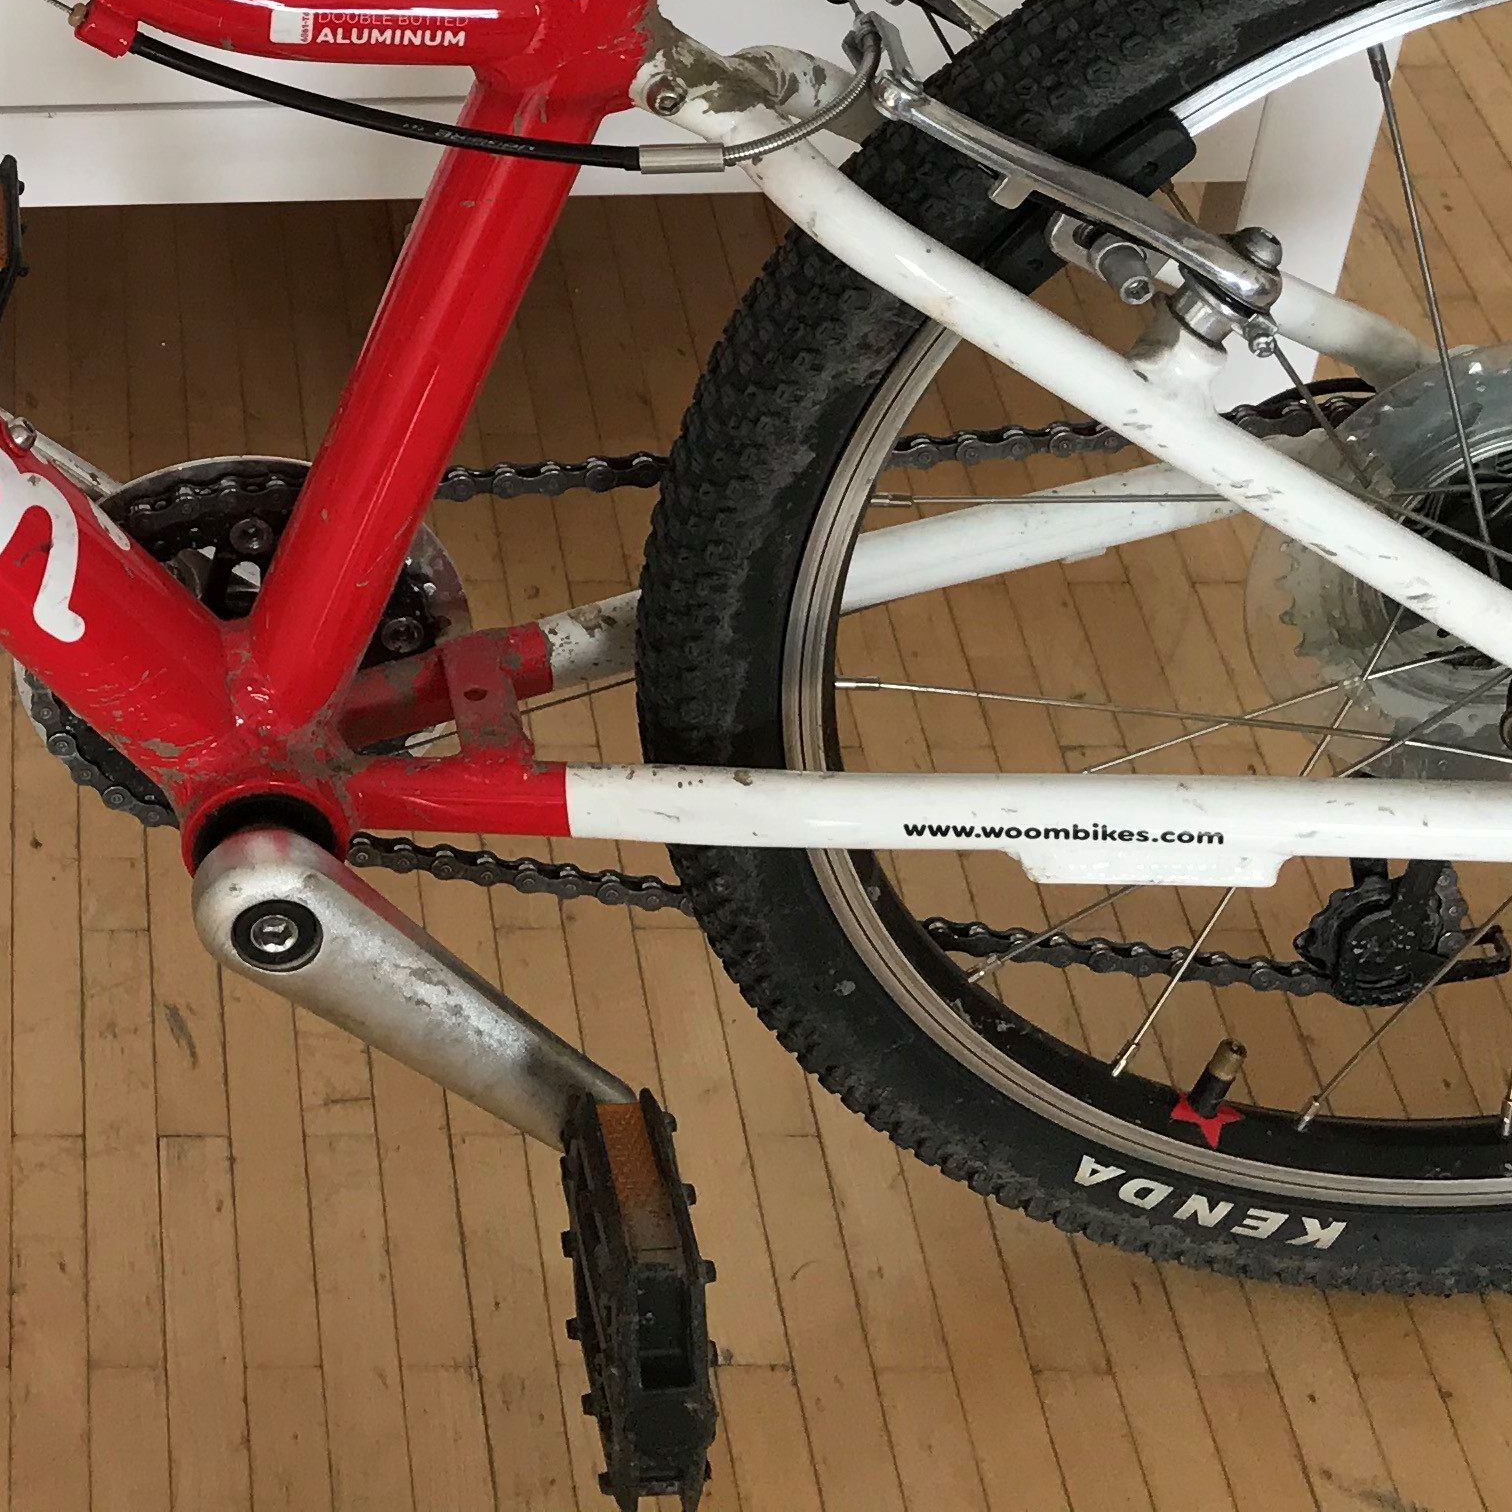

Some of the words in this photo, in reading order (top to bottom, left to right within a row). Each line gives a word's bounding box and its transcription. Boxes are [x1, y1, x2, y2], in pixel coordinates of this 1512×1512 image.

[316, 27, 466, 47] ALUMINUM
[903, 822, 1225, 845] www.woombikes.com
[1074, 1155, 1347, 1249] KENDA
